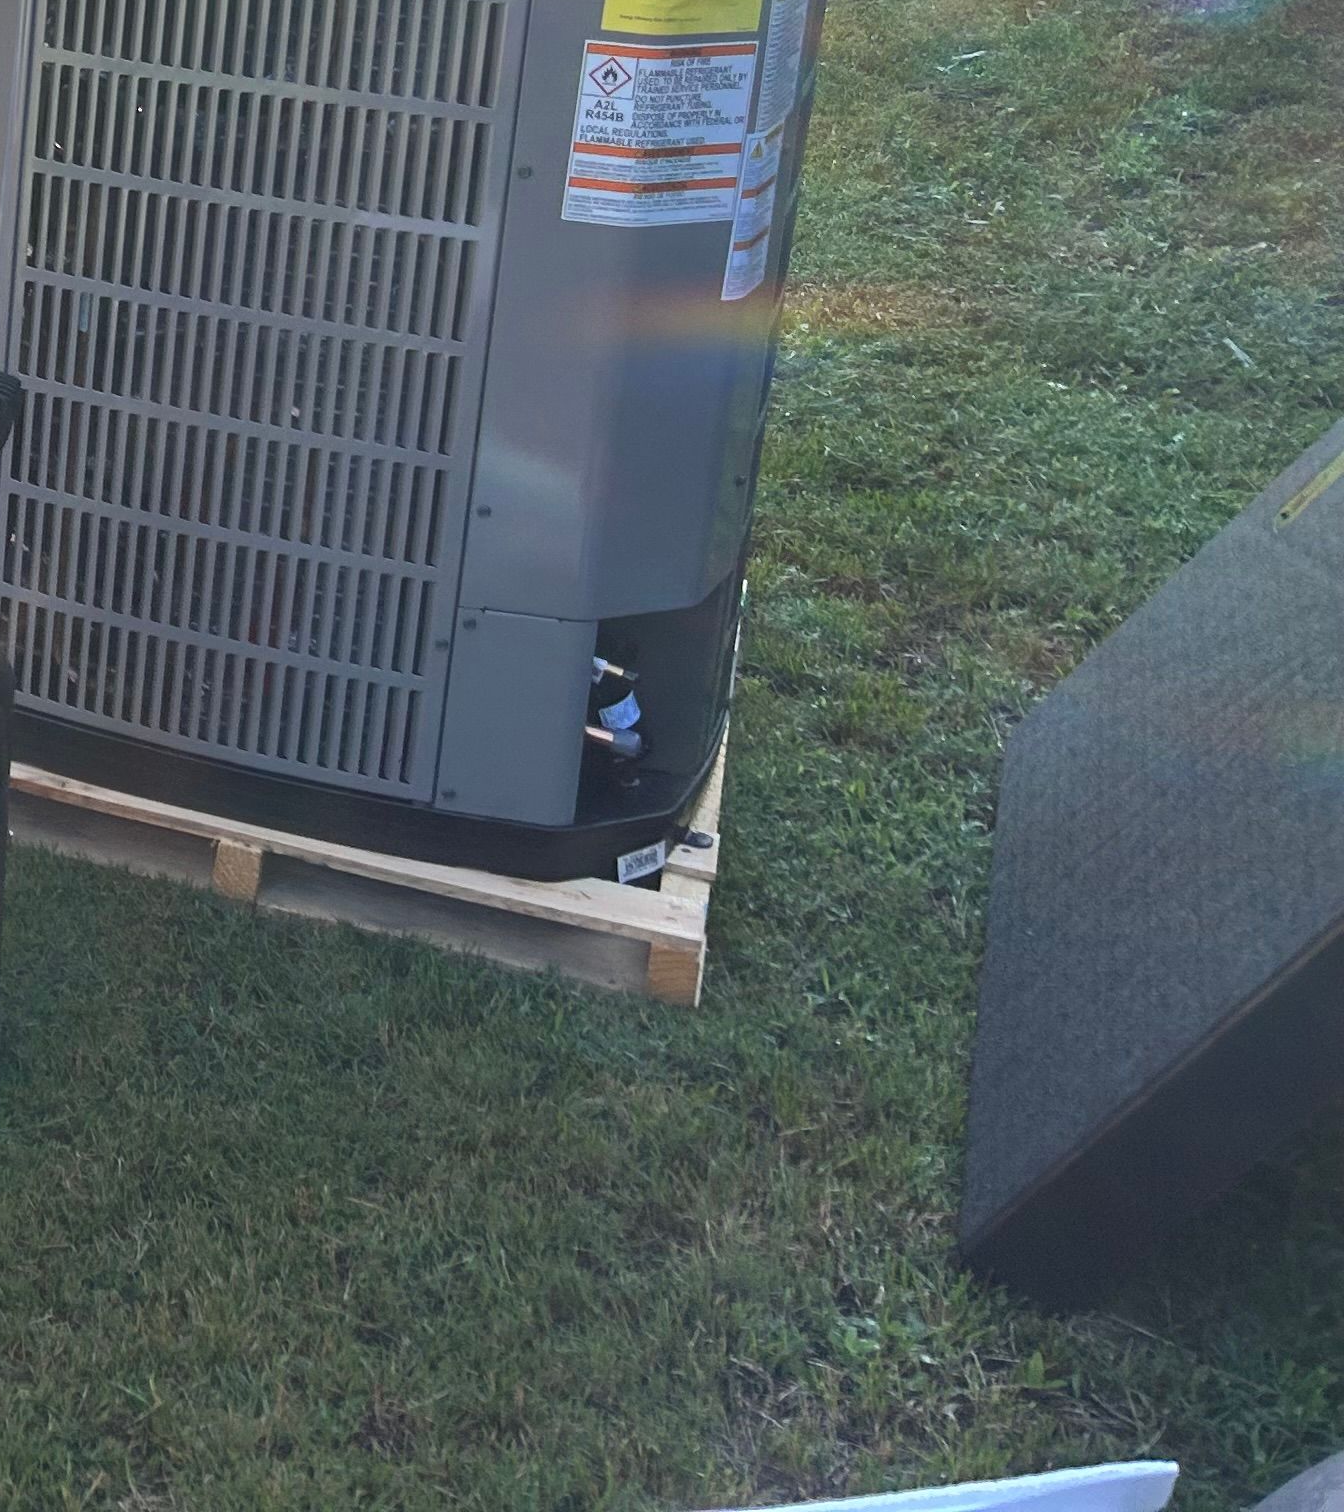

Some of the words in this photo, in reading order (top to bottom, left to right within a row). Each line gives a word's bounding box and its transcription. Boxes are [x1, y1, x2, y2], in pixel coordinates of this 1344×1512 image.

[594, 99, 617, 110] A2L
[585, 109, 624, 122] R454B
[580, 125, 609, 135] LOCAL
